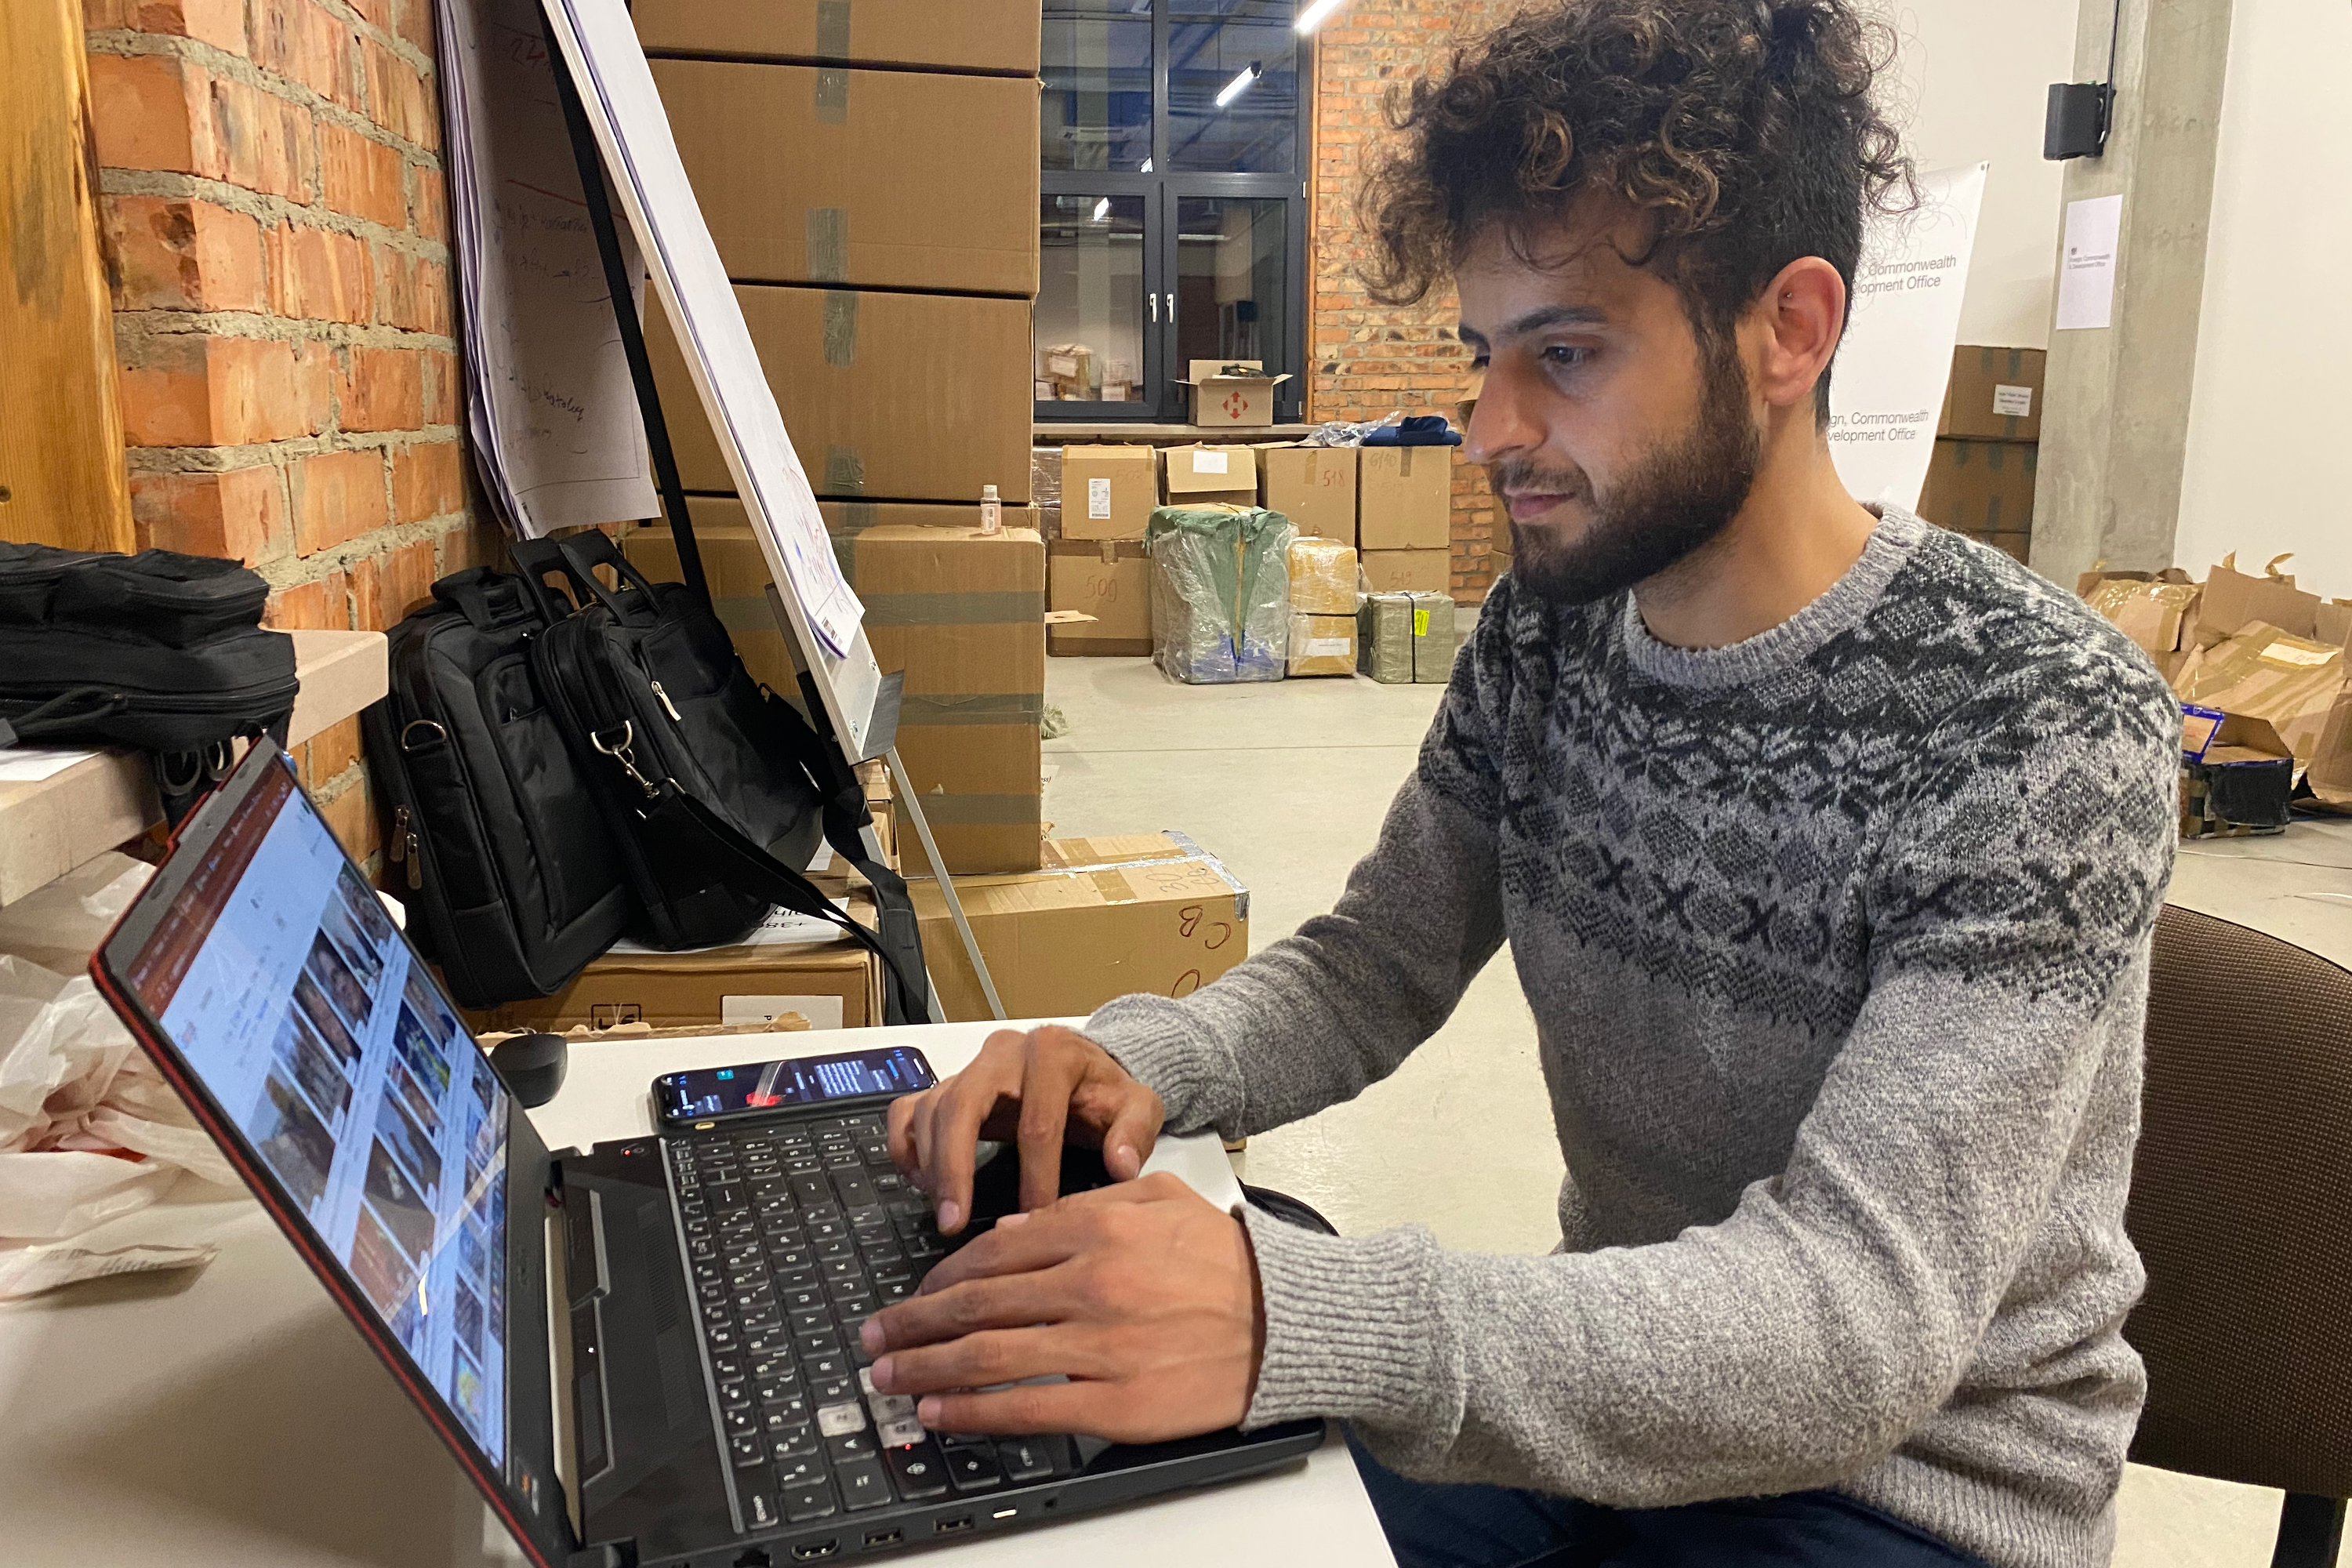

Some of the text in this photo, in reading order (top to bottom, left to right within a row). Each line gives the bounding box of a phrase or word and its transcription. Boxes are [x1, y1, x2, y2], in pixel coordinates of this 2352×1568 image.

[1868, 255, 1957, 275] Commonwealth
[1857, 275, 1941, 296] lopment Office
[1851, 409, 1928, 424] Commonwealth
[1828, 428, 1916, 444] velopment Office
[1322, 470, 1345, 488] 518
[1083, 574, 1118, 603] 509
[1145, 873, 1189, 892] 30
